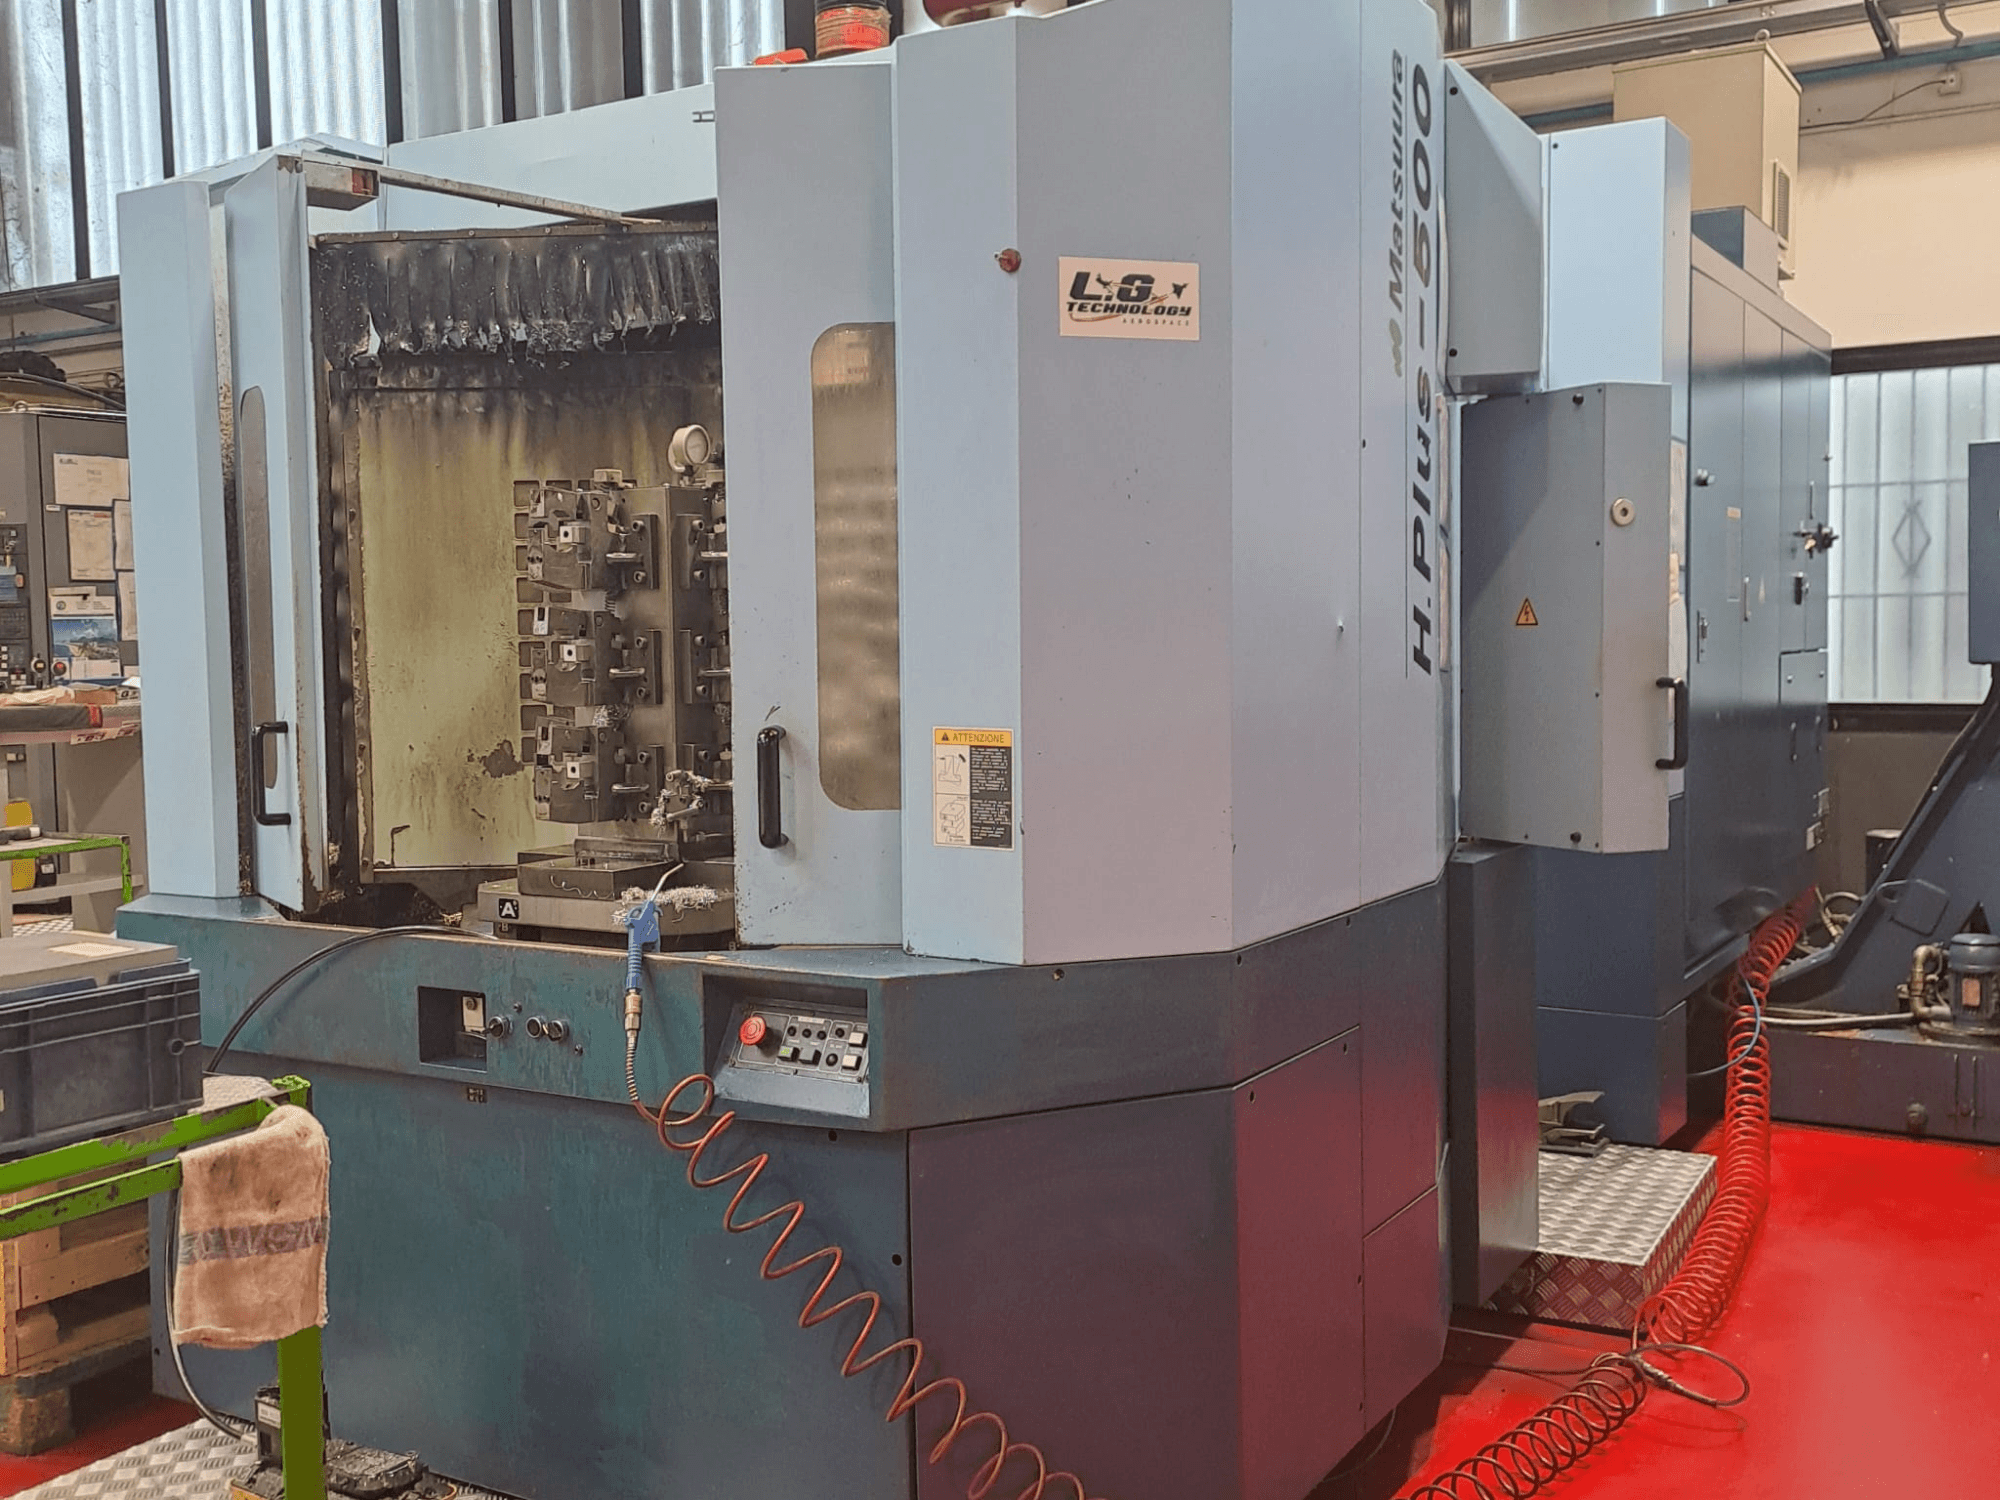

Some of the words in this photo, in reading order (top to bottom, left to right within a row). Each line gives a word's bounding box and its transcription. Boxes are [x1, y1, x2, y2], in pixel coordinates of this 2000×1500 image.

[1388, 48, 1404, 312] Matsuura
[1066, 301, 1192, 317] TECHNOLOGY
[952, 732, 1005, 744] ATTENZIONE
[501, 902, 516, 917] A
